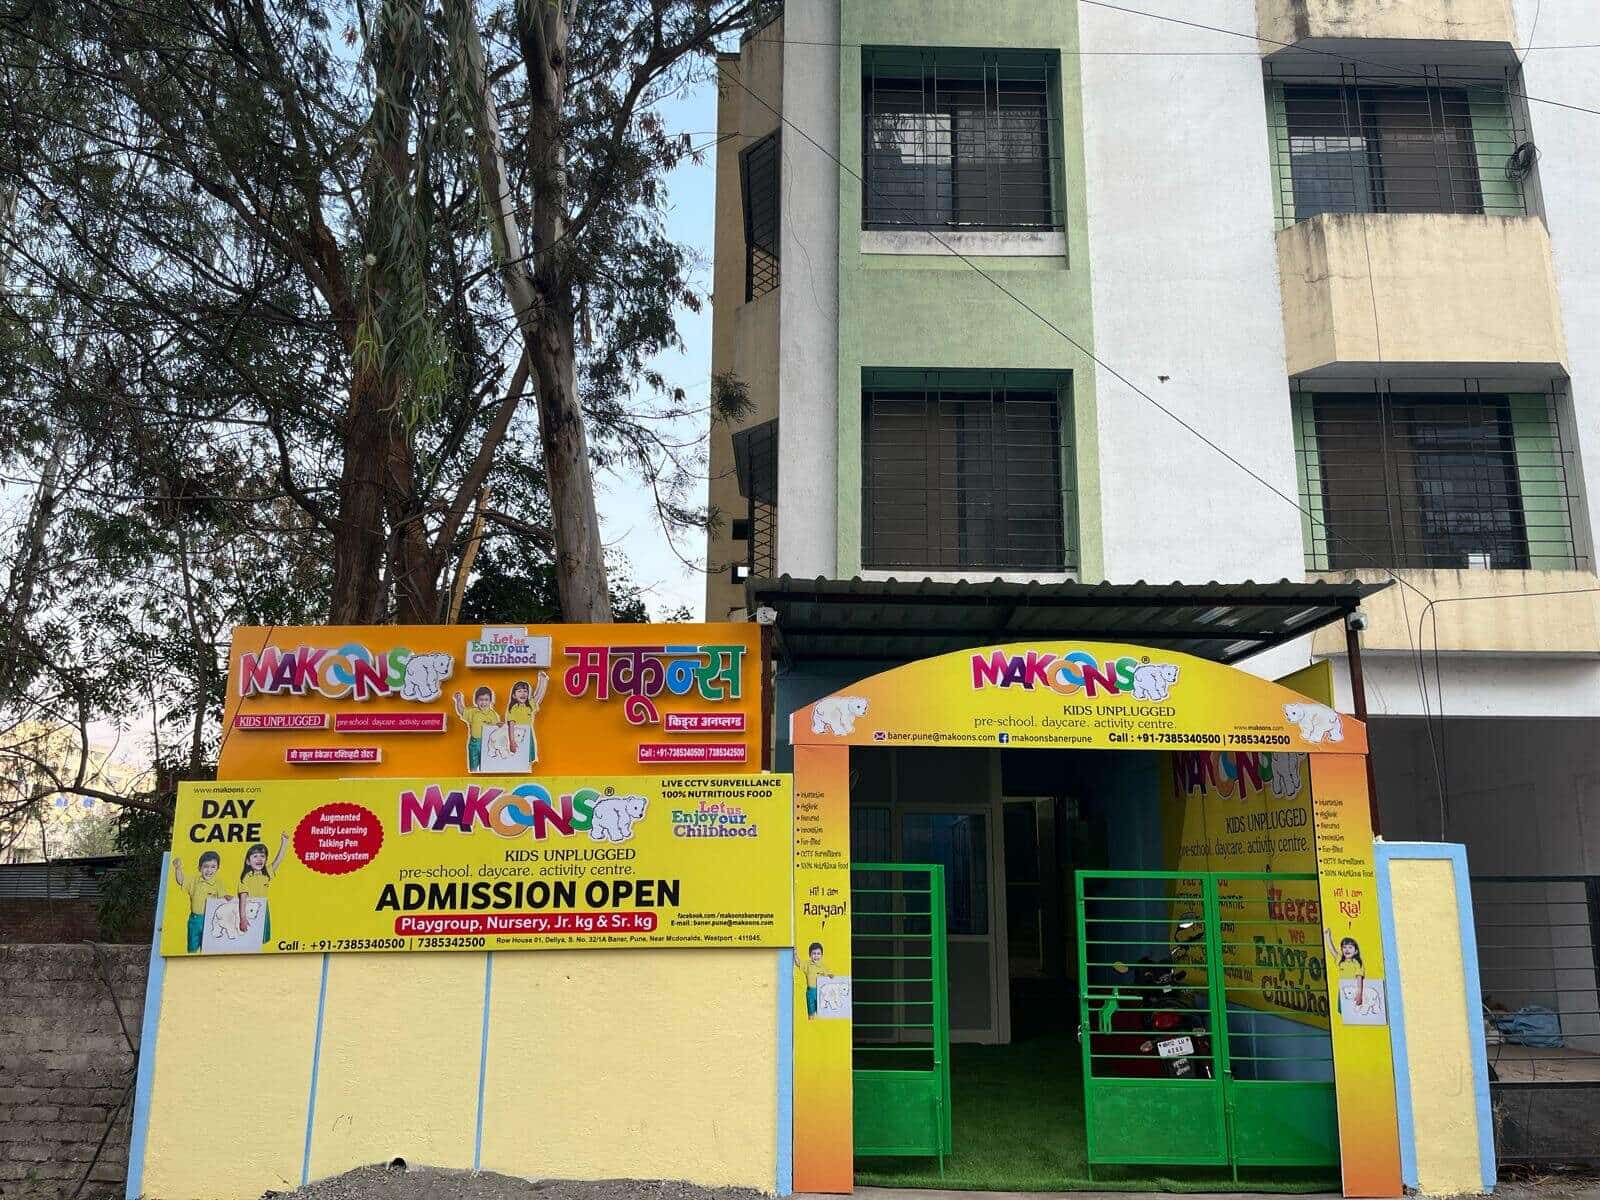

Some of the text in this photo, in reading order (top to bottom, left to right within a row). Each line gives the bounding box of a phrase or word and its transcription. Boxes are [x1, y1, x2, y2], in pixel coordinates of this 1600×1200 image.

[472, 641, 529, 654] Enjoy our
[240, 644, 412, 701] MAKOONS
[971, 649, 1139, 698] MAKOONS
[1063, 705, 1176, 718] KIDS UNPLUGGED
[239, 716, 320, 728] KIDS UNPLUGGED
[1094, 719, 1134, 730] activity
[888, 732, 1092, 744] baner.pune@makoons.com makoonsbanerpune
[1108, 732, 1129, 742] Call
[1136, 734, 1221, 744] +91-7385340500
[1230, 734, 1290, 744] 7385342500
[640, 748, 652, 758] Call
[708, 748, 744, 758] 7385342500
[662, 779, 782, 788] LIVE CCTV SURVEILLANCE
[662, 790, 773, 798] 100% NUTRITIOUS FOOD
[202, 799, 256, 819] DAY
[400, 783, 596, 840] MAKOONS
[699, 800, 742, 816] Let us
[320, 812, 360, 823] Augmented
[672, 810, 747, 826] Enjoy our
[1226, 816, 1246, 834] KIDS
[1248, 808, 1307, 832] UNPLUGGED
[190, 823, 262, 844] CARE
[310, 826, 368, 837] Reality Learning
[318, 838, 358, 850] Talking Pen
[1248, 834, 1276, 858] activity
[304, 852, 318, 862] ERP
[504, 848, 636, 862] KIDS UNPLUGGED
[538, 864, 586, 879] activity
[375, 879, 681, 911] ADMISSION OPEN
[827, 888, 839, 896] am
[804, 901, 846, 918] Aaryan!
[1268, 887, 1319, 925] Here
[400, 914, 652, 933] Playgroup, Nursery, Jr. kg & Sr. kg
[278, 940, 299, 952] Call
[310, 938, 405, 950] +91-7385340500
[417, 938, 486, 948] 7385342500
[1254, 936, 1307, 985] Enjoy
